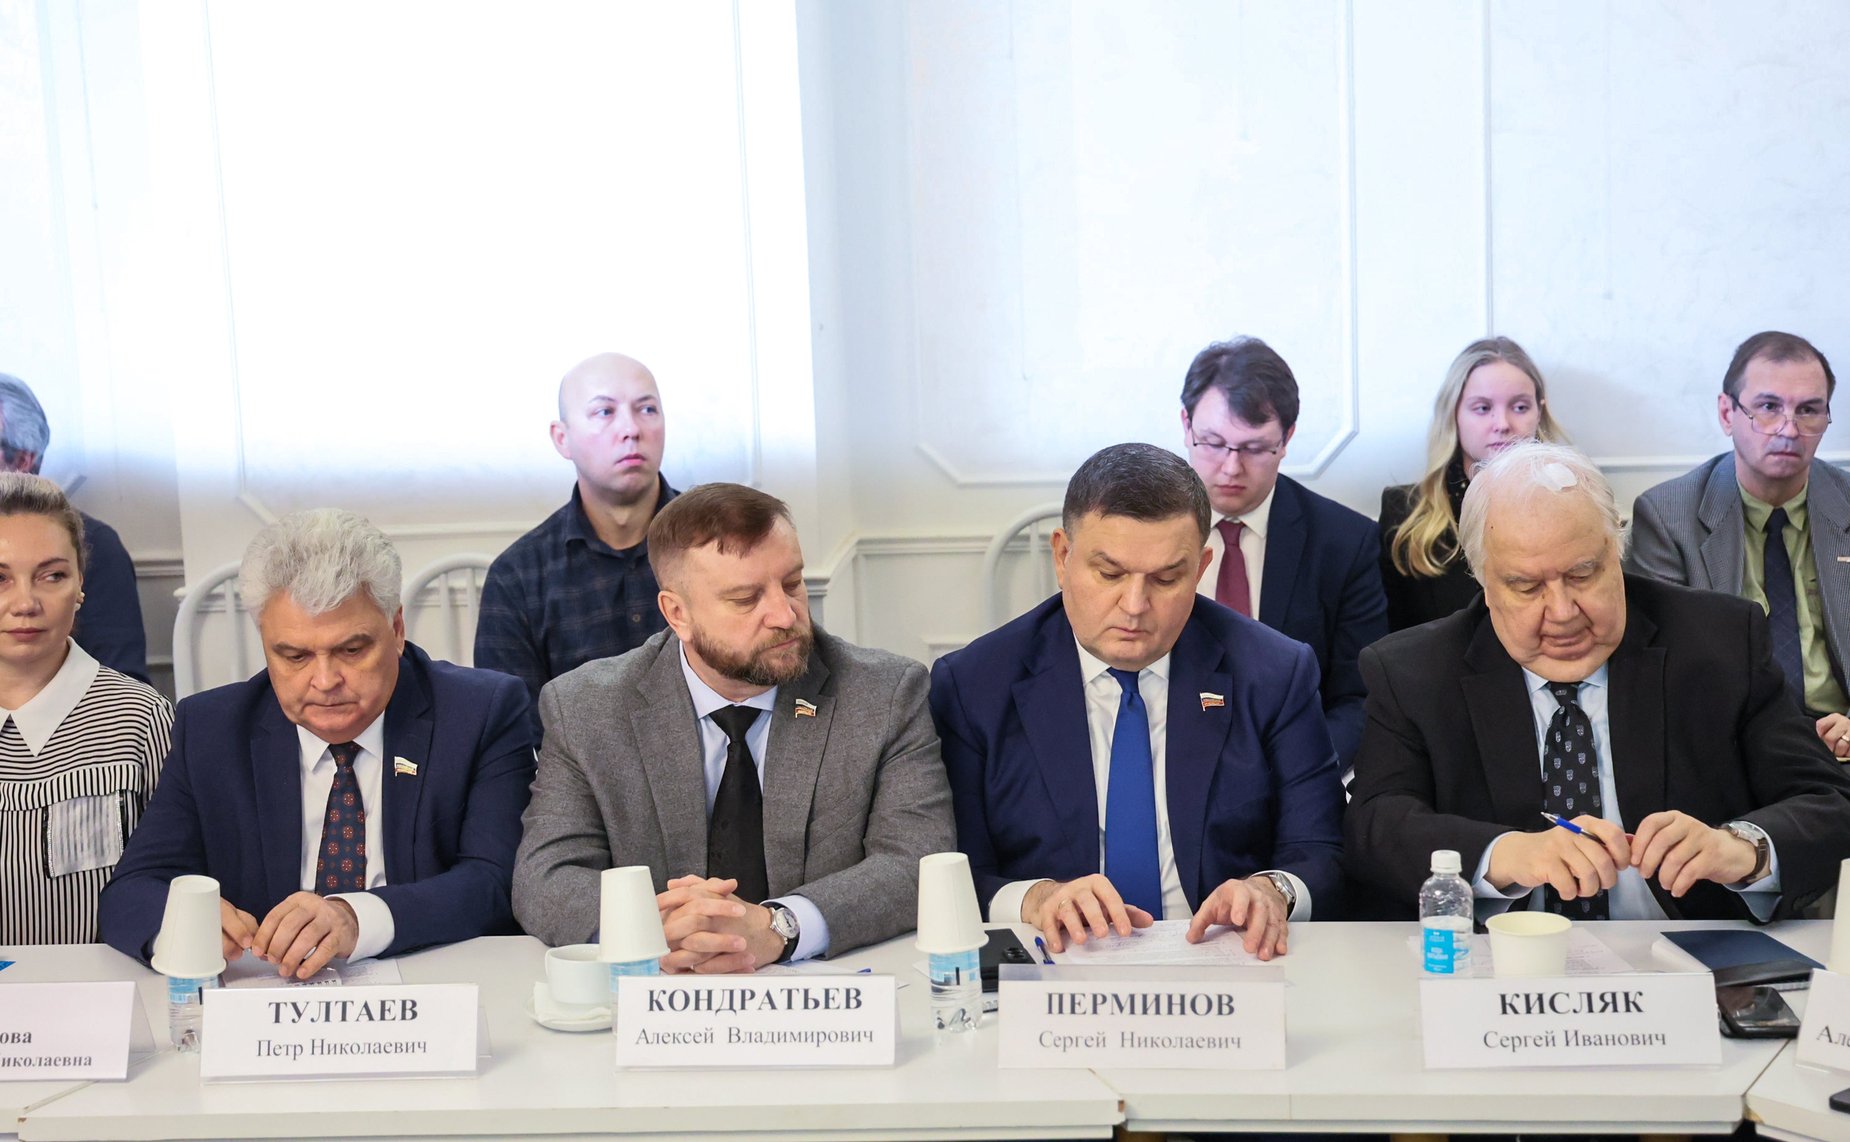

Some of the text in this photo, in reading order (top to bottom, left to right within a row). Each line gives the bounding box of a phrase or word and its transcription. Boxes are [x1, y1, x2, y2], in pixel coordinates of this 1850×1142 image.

[267, 998, 419, 1024] ТУЛТАЕВ
[647, 987, 863, 1015] КОНДРАТЬЕВ
[1047, 992, 1235, 1017] ПЕРМИНОВ
[1498, 990, 1645, 1016] КИСЛЯК
[257, 1037, 427, 1062] Петр Николаевич
[635, 1026, 874, 1048] Алексей Владимирович
[1038, 1031, 1241, 1053] Сергей Николаевич
[1483, 1029, 1667, 1053] Сергей Иванович
[0, 1055, 92, 1068] иколаевна
